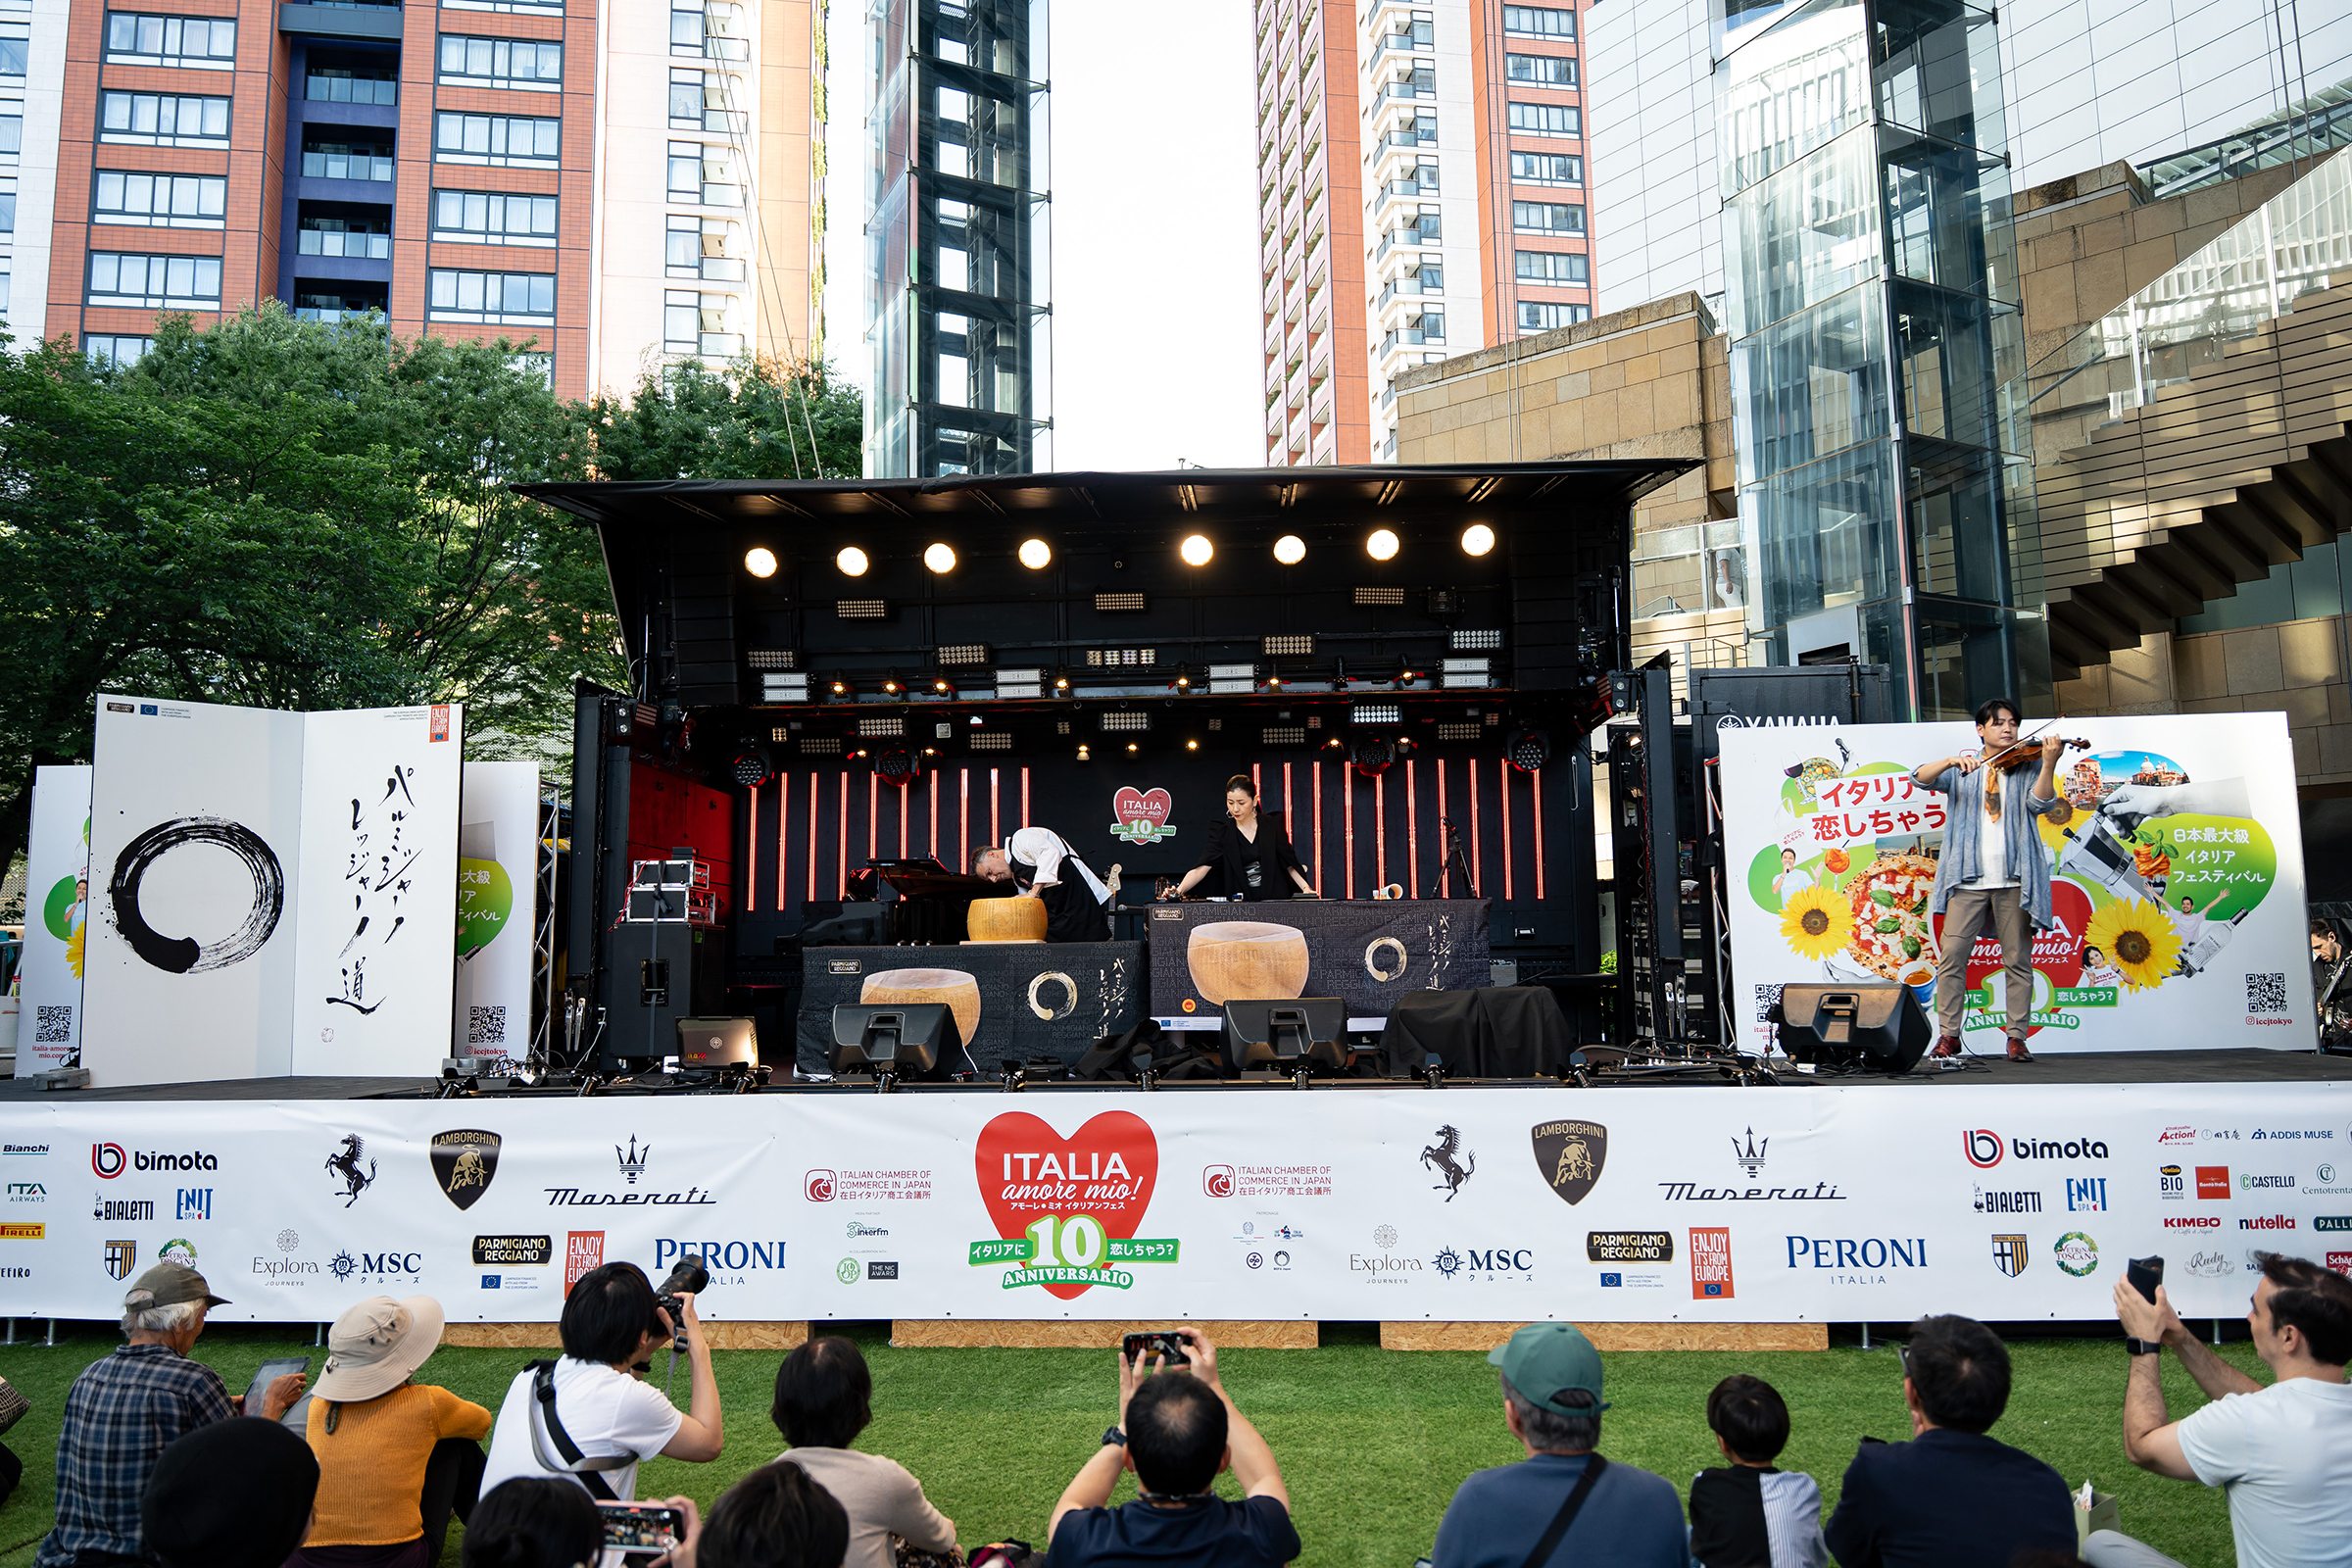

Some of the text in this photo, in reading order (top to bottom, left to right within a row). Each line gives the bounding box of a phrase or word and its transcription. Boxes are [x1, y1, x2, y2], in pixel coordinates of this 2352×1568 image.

[432, 708, 449, 718] ENJOY
[1123, 801, 1162, 810] ITALIA
[1130, 819, 1152, 834] 10
[2174, 827, 2249, 844] 日本最大級
[2185, 850, 2236, 864] イタリア
[2174, 869, 2266, 884] フェスティバル
[1185, 906, 1255, 916] PARMIGIANO
[1319, 905, 1390, 916] PARMIGIANO
[2057, 991, 2114, 1003] 恋しちゃう?
[2256, 1017, 2293, 1026] iccjtokyo
[1535, 1123, 1604, 1139] LAMBORGHINI
[2158, 1129, 2196, 1143] Action!
[2270, 1130, 2333, 1140] ADDIS MUSE
[434, 1132, 499, 1148] LAMBORGHINI
[2013, 1138, 2109, 1159] bimota
[134, 1151, 219, 1171] bimota
[1004, 1152, 1131, 1181] ITALIA
[875, 1170, 917, 1179] CHAMBER
[1238, 1166, 1272, 1175] ITALIAN
[1274, 1166, 1316, 1175] CHAMBER
[840, 1181, 889, 1190] COMMERCE
[1002, 1175, 1144, 1201] amore mio!
[1238, 1177, 1289, 1186] COMMERCE
[2161, 1176, 2183, 1191] BIO
[2251, 1175, 2295, 1188] CASTELLO
[8, 1183, 47, 1195] ITA
[543, 1187, 716, 1205] Maserati
[840, 1191, 932, 1200] 在日イタリア商工会議所
[1238, 1187, 1332, 1197] 在日イタリア商工会議所
[1658, 1182, 1846, 1200] Maserati
[2066, 1178, 2107, 1211] ENIT
[176, 1188, 214, 1220] ENIT
[1065, 1200, 1126, 1211] イタリアンフェス
[2164, 1217, 2221, 1227] KIMBO
[2239, 1214, 2296, 1230] nutella
[0, 1225, 41, 1237] PIRELLI
[858, 1227, 889, 1236] interfm
[479, 1238, 546, 1250] PARMIGIANO
[569, 1237, 603, 1254] ENJOY
[1031, 1215, 1102, 1267] 10
[1592, 1235, 1666, 1247] PARMIGIANO
[1691, 1233, 1728, 1252] ENJOY
[484, 1250, 539, 1261] REGGIANO
[971, 1242, 1025, 1258] イタリアに
[1109, 1242, 1175, 1258] 恋しちゃう?
[1600, 1247, 1660, 1258] REGGIANO
[1786, 1235, 1928, 1268] PERONI
[2062, 1244, 2092, 1253] VETRINA
[362, 1252, 421, 1273] MSC
[568, 1255, 599, 1267] IT'S FROM
[1350, 1253, 1423, 1276] Explora
[1468, 1250, 1533, 1271] MSC
[1694, 1252, 1728, 1265] IT'S FROM
[2190, 1250, 2228, 1273] Rudy
[0, 1267, 30, 1278] EFIRO
[252, 1256, 319, 1279] Explora
[1694, 1265, 1730, 1282] EUROPE
[1003, 1267, 1131, 1287] ANNIVERSARIO
[1831, 1275, 1886, 1285] ITALIA
